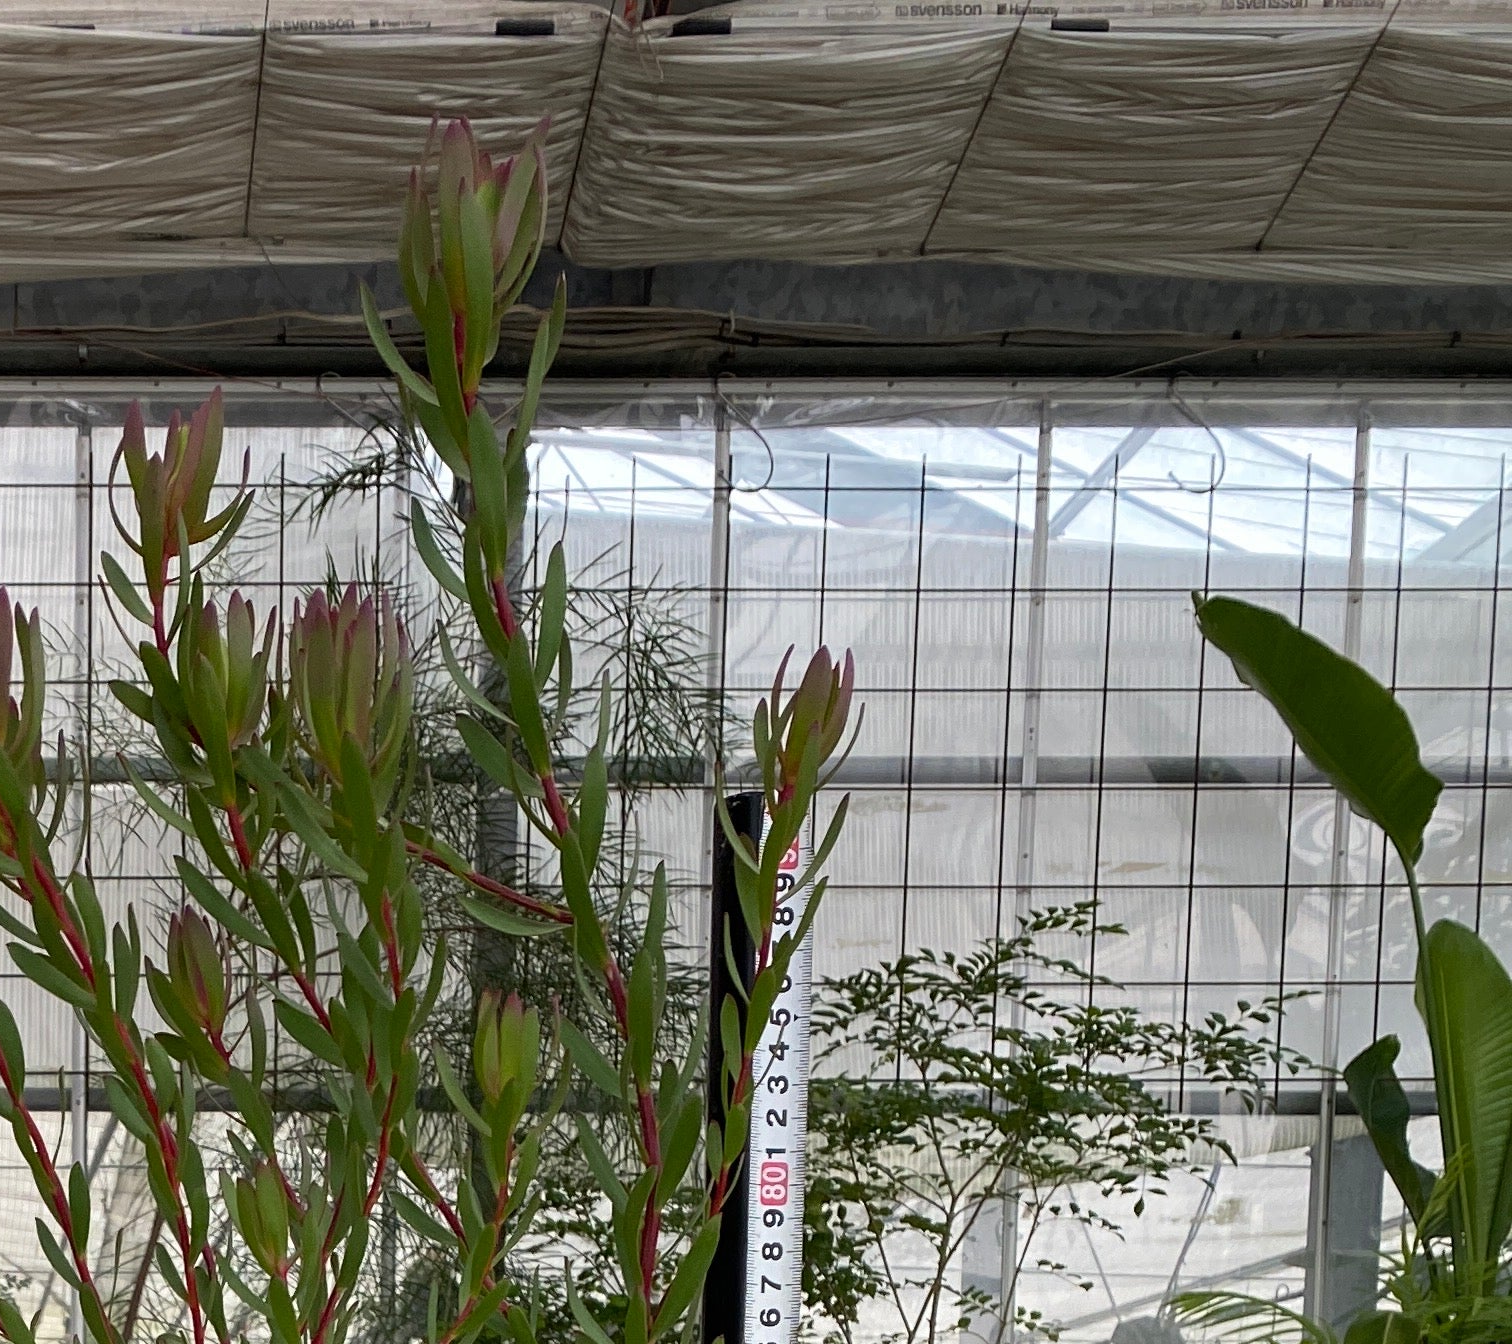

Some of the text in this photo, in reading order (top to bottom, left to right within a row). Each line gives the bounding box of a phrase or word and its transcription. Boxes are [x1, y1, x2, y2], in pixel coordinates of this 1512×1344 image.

[910, 3, 983, 17] svensson
[773, 906, 795, 926] 8
[770, 1007, 791, 1026] 5
[768, 1041, 790, 1060] 4
[767, 1075, 789, 1095] 3
[766, 1108, 788, 1127] 2
[765, 1148, 786, 1159] 1
[762, 1166, 786, 1199] 80
[762, 1208, 785, 1228] 9
[761, 1242, 784, 1261] 8
[760, 1275, 782, 1294] 7
[759, 1308, 781, 1328] 6
